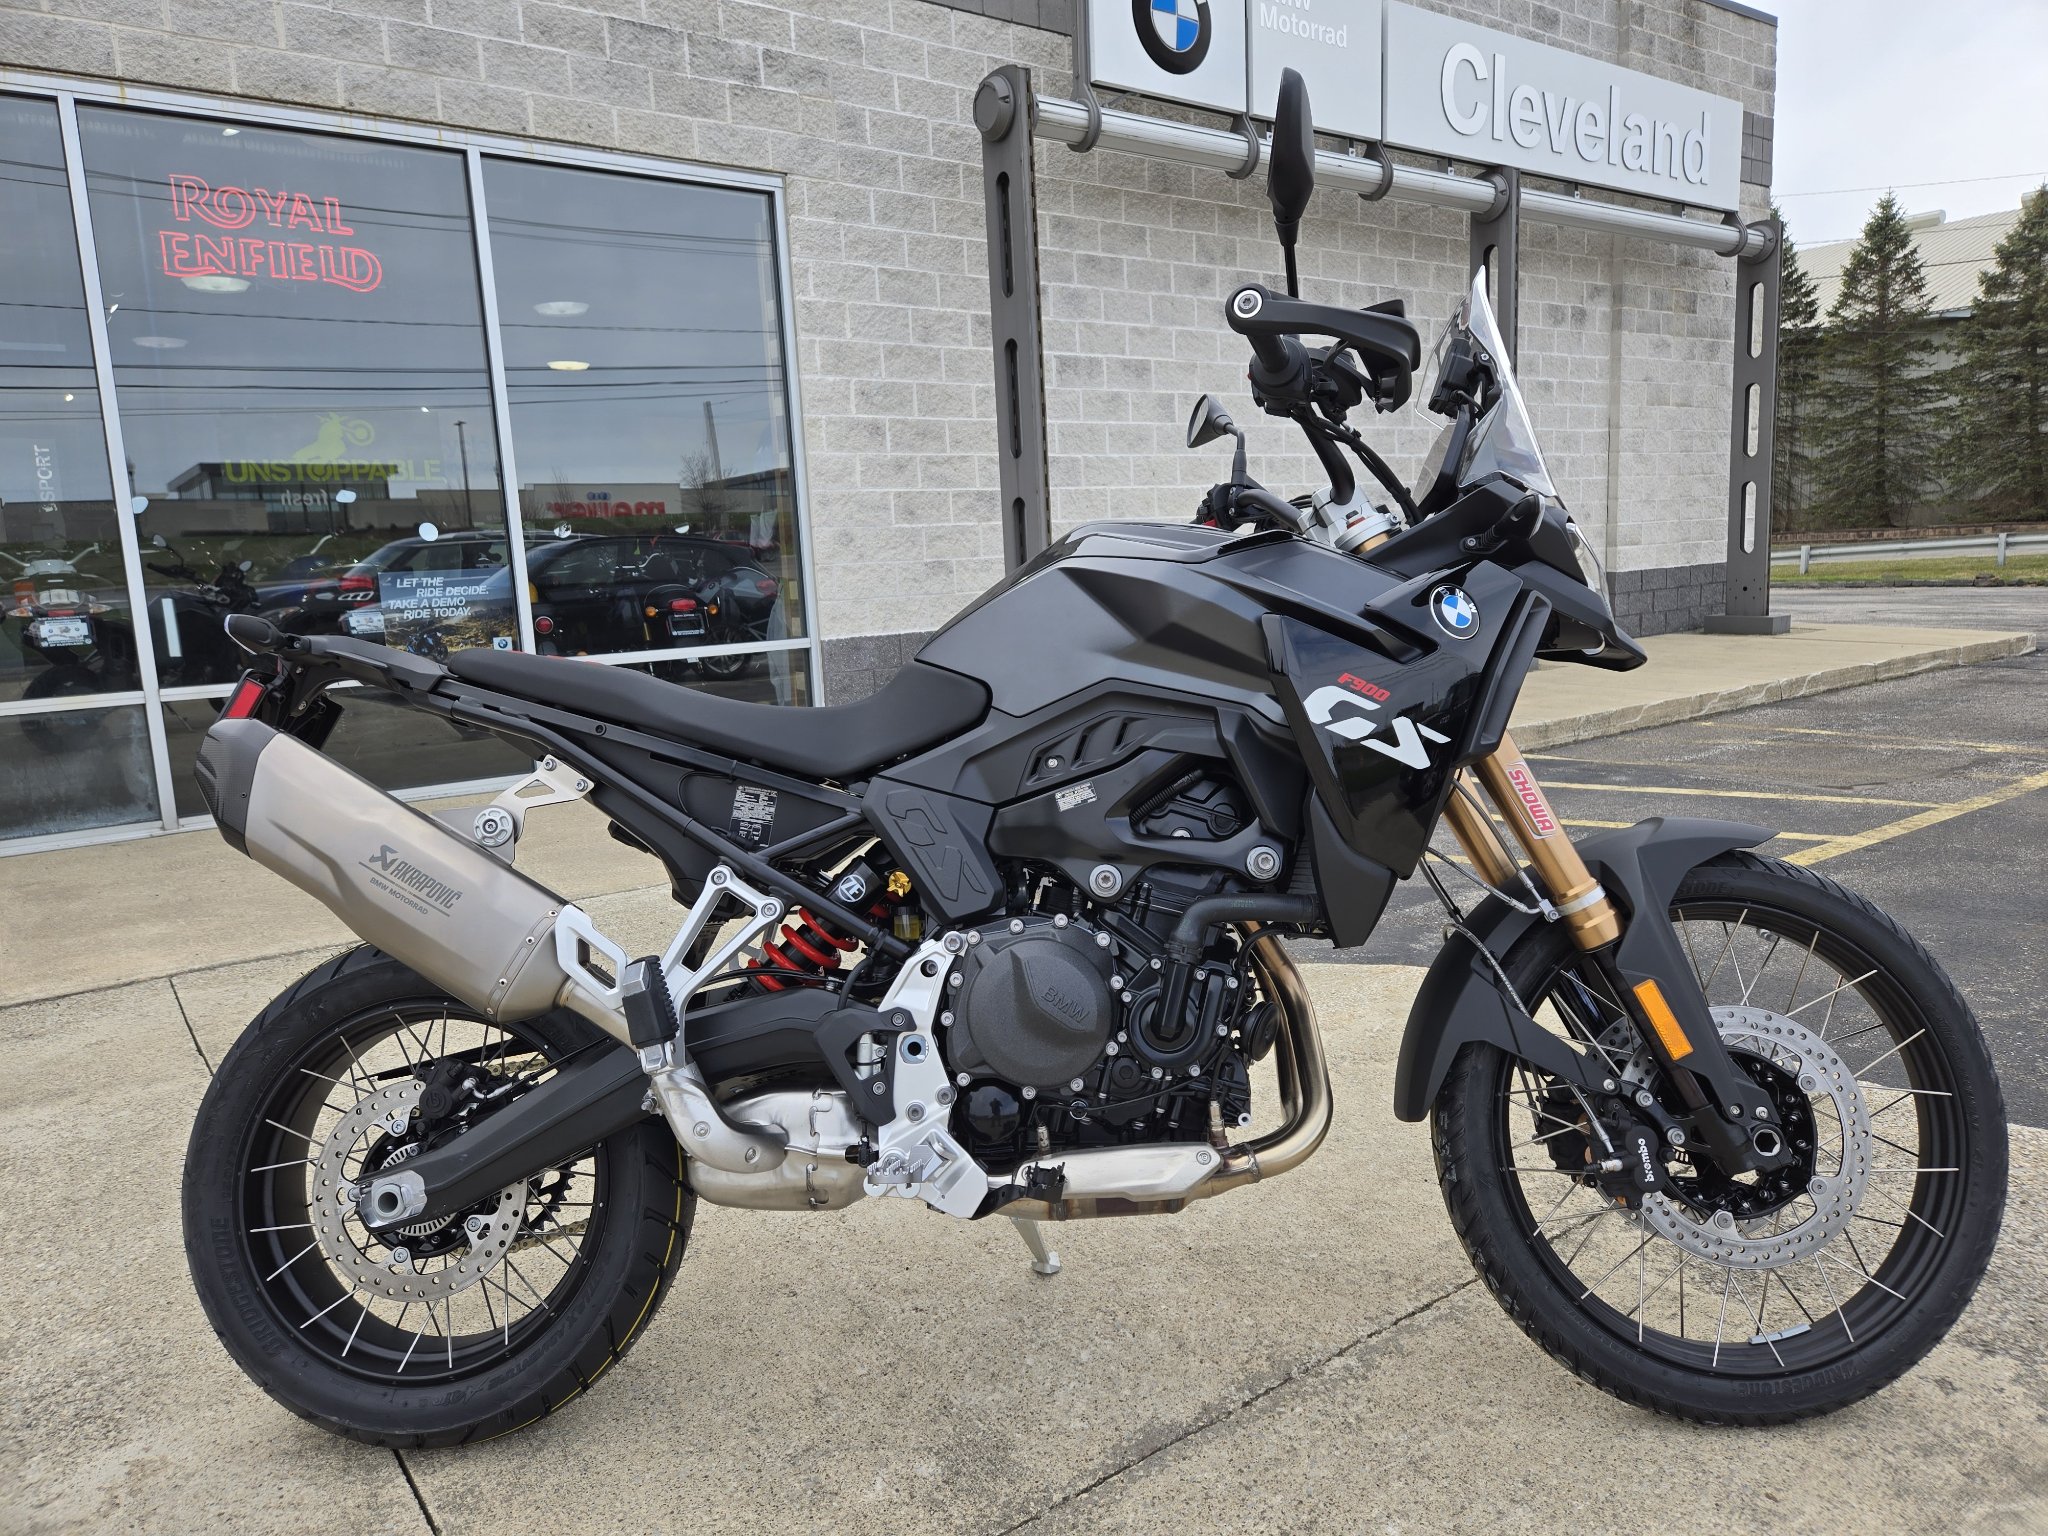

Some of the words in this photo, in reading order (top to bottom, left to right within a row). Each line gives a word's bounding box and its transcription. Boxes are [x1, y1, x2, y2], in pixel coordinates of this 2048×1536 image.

[1260, 3, 1347, 48] Motorrad
[1440, 43, 1711, 186] Cleveland
[168, 174, 354, 236] ROYAL
[158, 231, 383, 293] ENFIELD
[225, 459, 443, 483] UNSTOPPABLE
[396, 578, 417, 588] LET
[421, 577, 444, 587] THE
[416, 588, 443, 598] RIDE
[445, 586, 489, 597] DECIDE.
[389, 599, 419, 609] TAKE
[420, 599, 430, 608] A
[431, 597, 466, 608] DEMO
[403, 609, 431, 620] RIDE
[433, 607, 472, 618] TODAY.
[1337, 672, 1391, 702] F900
[1507, 769, 1556, 833] SHOWA
[369, 877, 389, 892] BMW
[388, 888, 429, 915] MOTORRAD
[840, 876, 867, 901] ZF
[1040, 986, 1090, 1024] BMW
[1637, 1137, 1656, 1183] brembo
